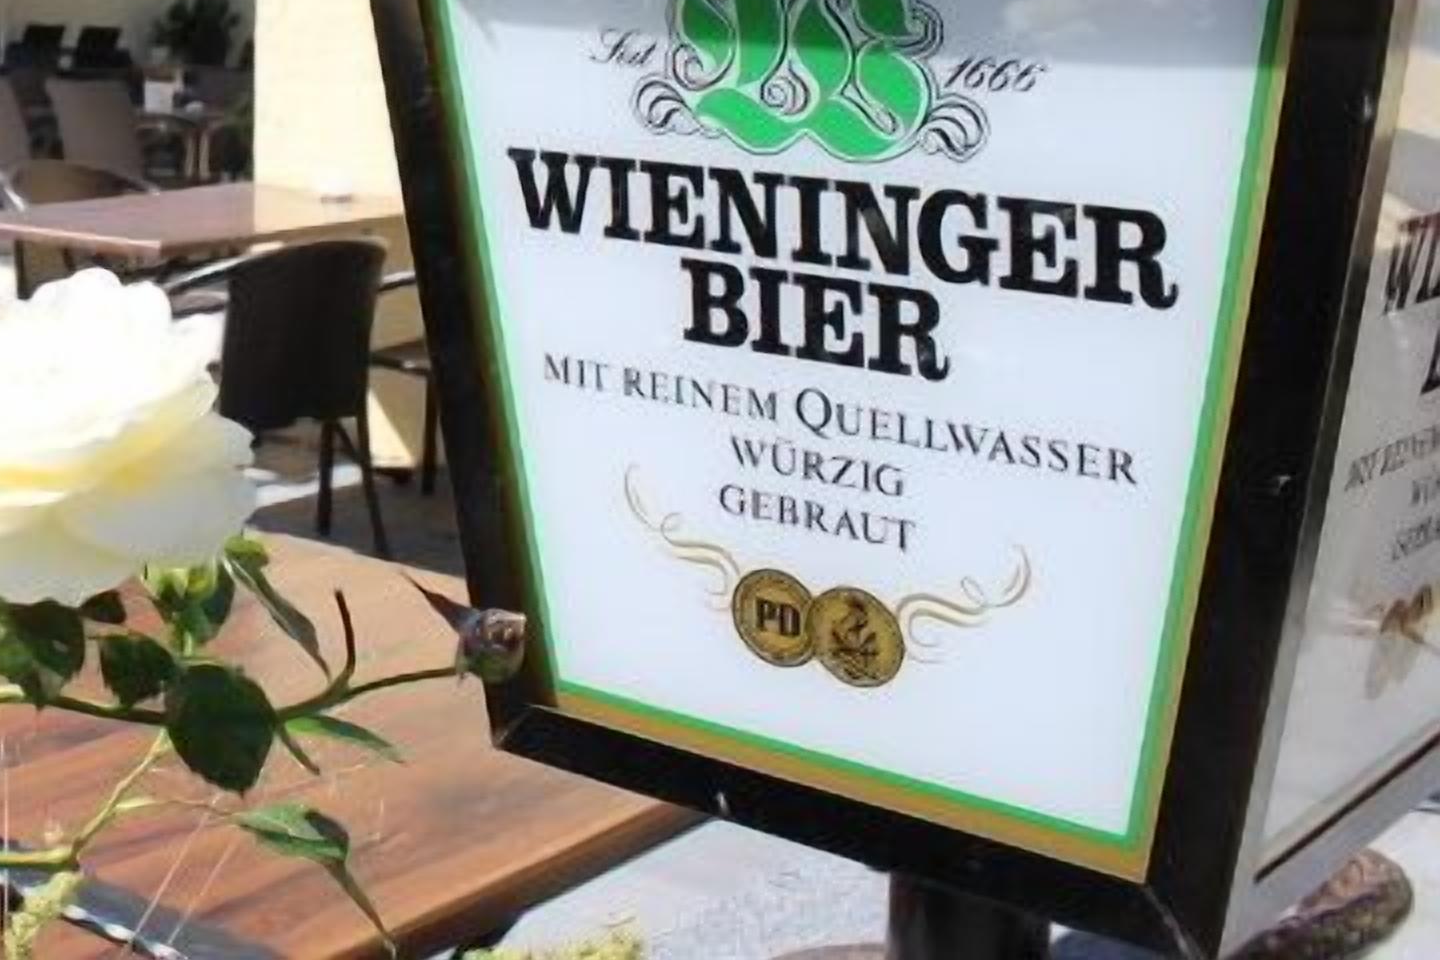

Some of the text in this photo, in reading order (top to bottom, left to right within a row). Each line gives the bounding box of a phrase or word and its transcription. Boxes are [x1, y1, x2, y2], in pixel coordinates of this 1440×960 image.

[943, 55, 1048, 92] 1666
[506, 147, 1179, 311] WIENINGER
[681, 258, 951, 382] BIER
[543, 351, 1139, 485] MIT REINEM QUELLWASSER
[729, 435, 905, 497] WÜRZIG
[718, 483, 917, 554] GEBRAUT
